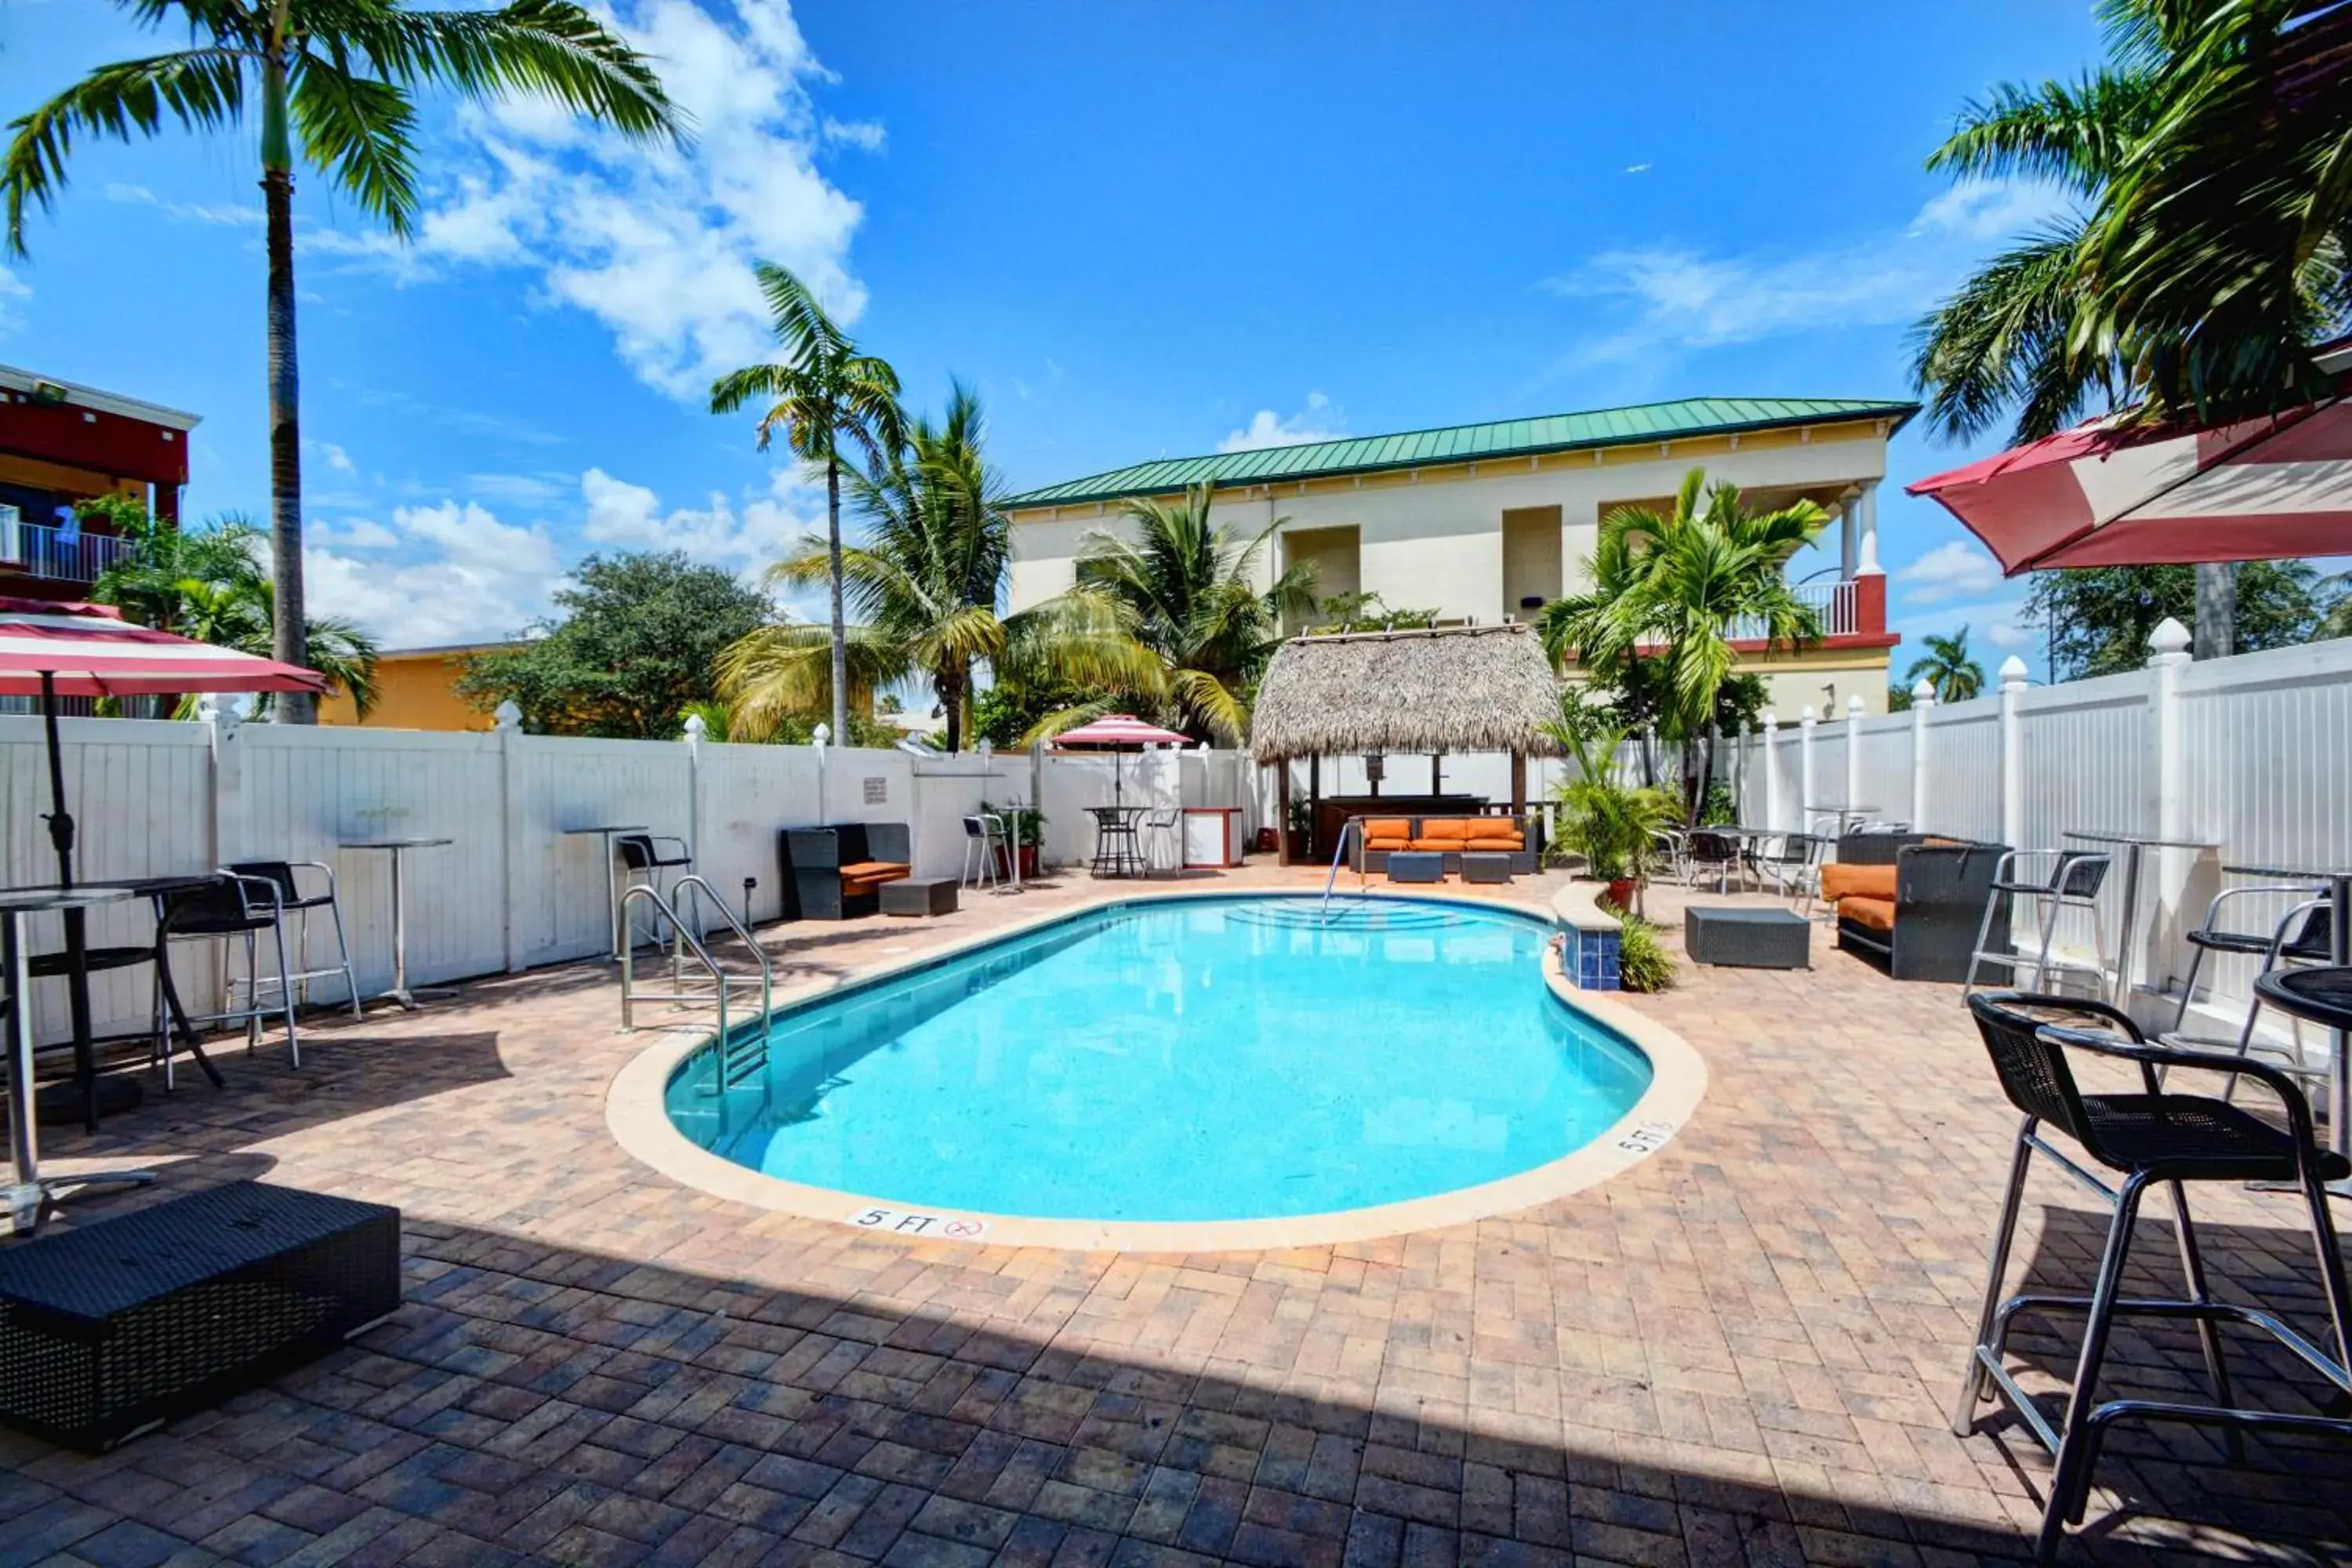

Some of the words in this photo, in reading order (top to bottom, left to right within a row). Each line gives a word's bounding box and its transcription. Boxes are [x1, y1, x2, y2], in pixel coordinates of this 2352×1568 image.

[1618, 1142, 1649, 1152] 5
[858, 1210, 891, 1225] 5
[895, 1215, 938, 1232] FT
